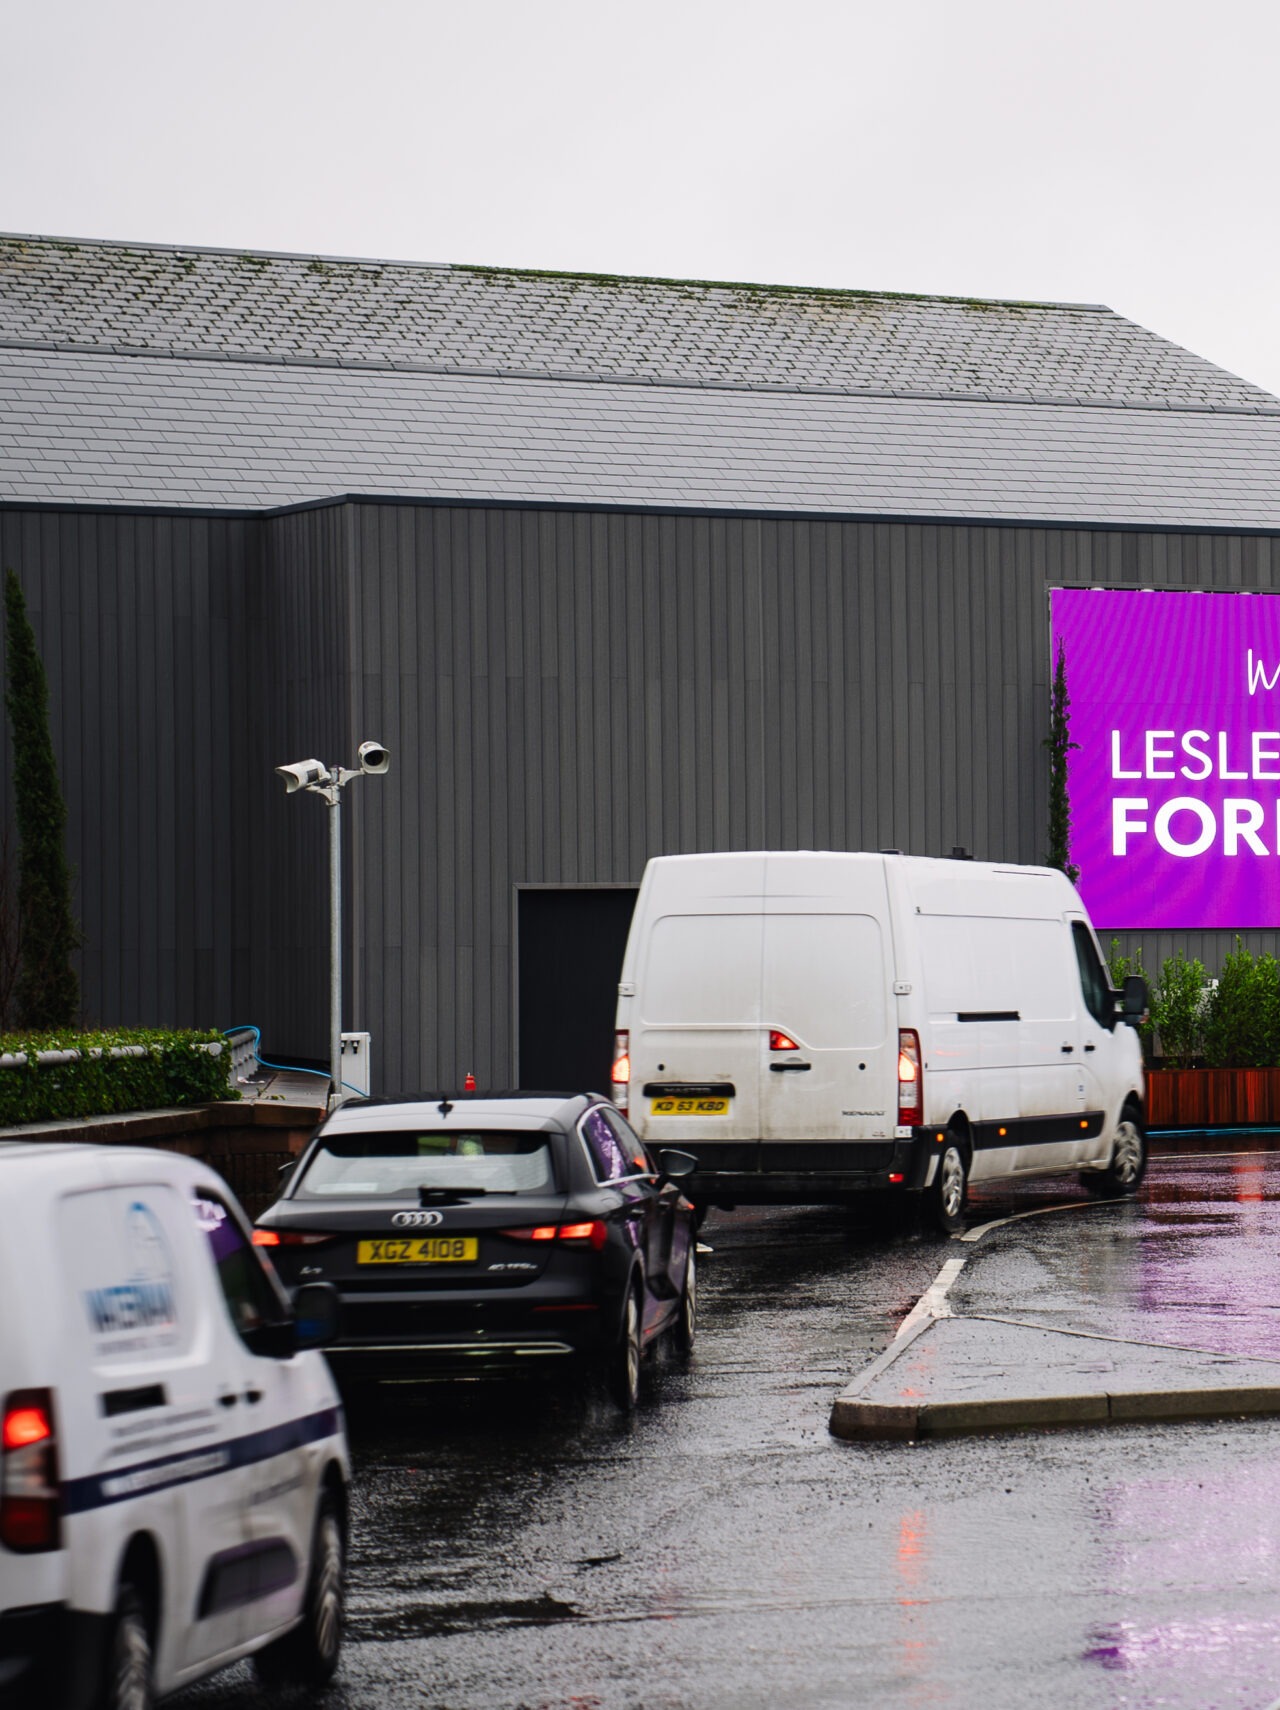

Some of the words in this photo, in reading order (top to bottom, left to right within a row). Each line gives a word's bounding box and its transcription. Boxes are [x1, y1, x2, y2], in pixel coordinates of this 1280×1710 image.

[654, 1101, 675, 1111] KD
[676, 1101, 694, 1111] 63
[695, 1101, 725, 1111] KBD
[370, 1241, 411, 1260] XGZ
[419, 1240, 465, 1259] 4108
